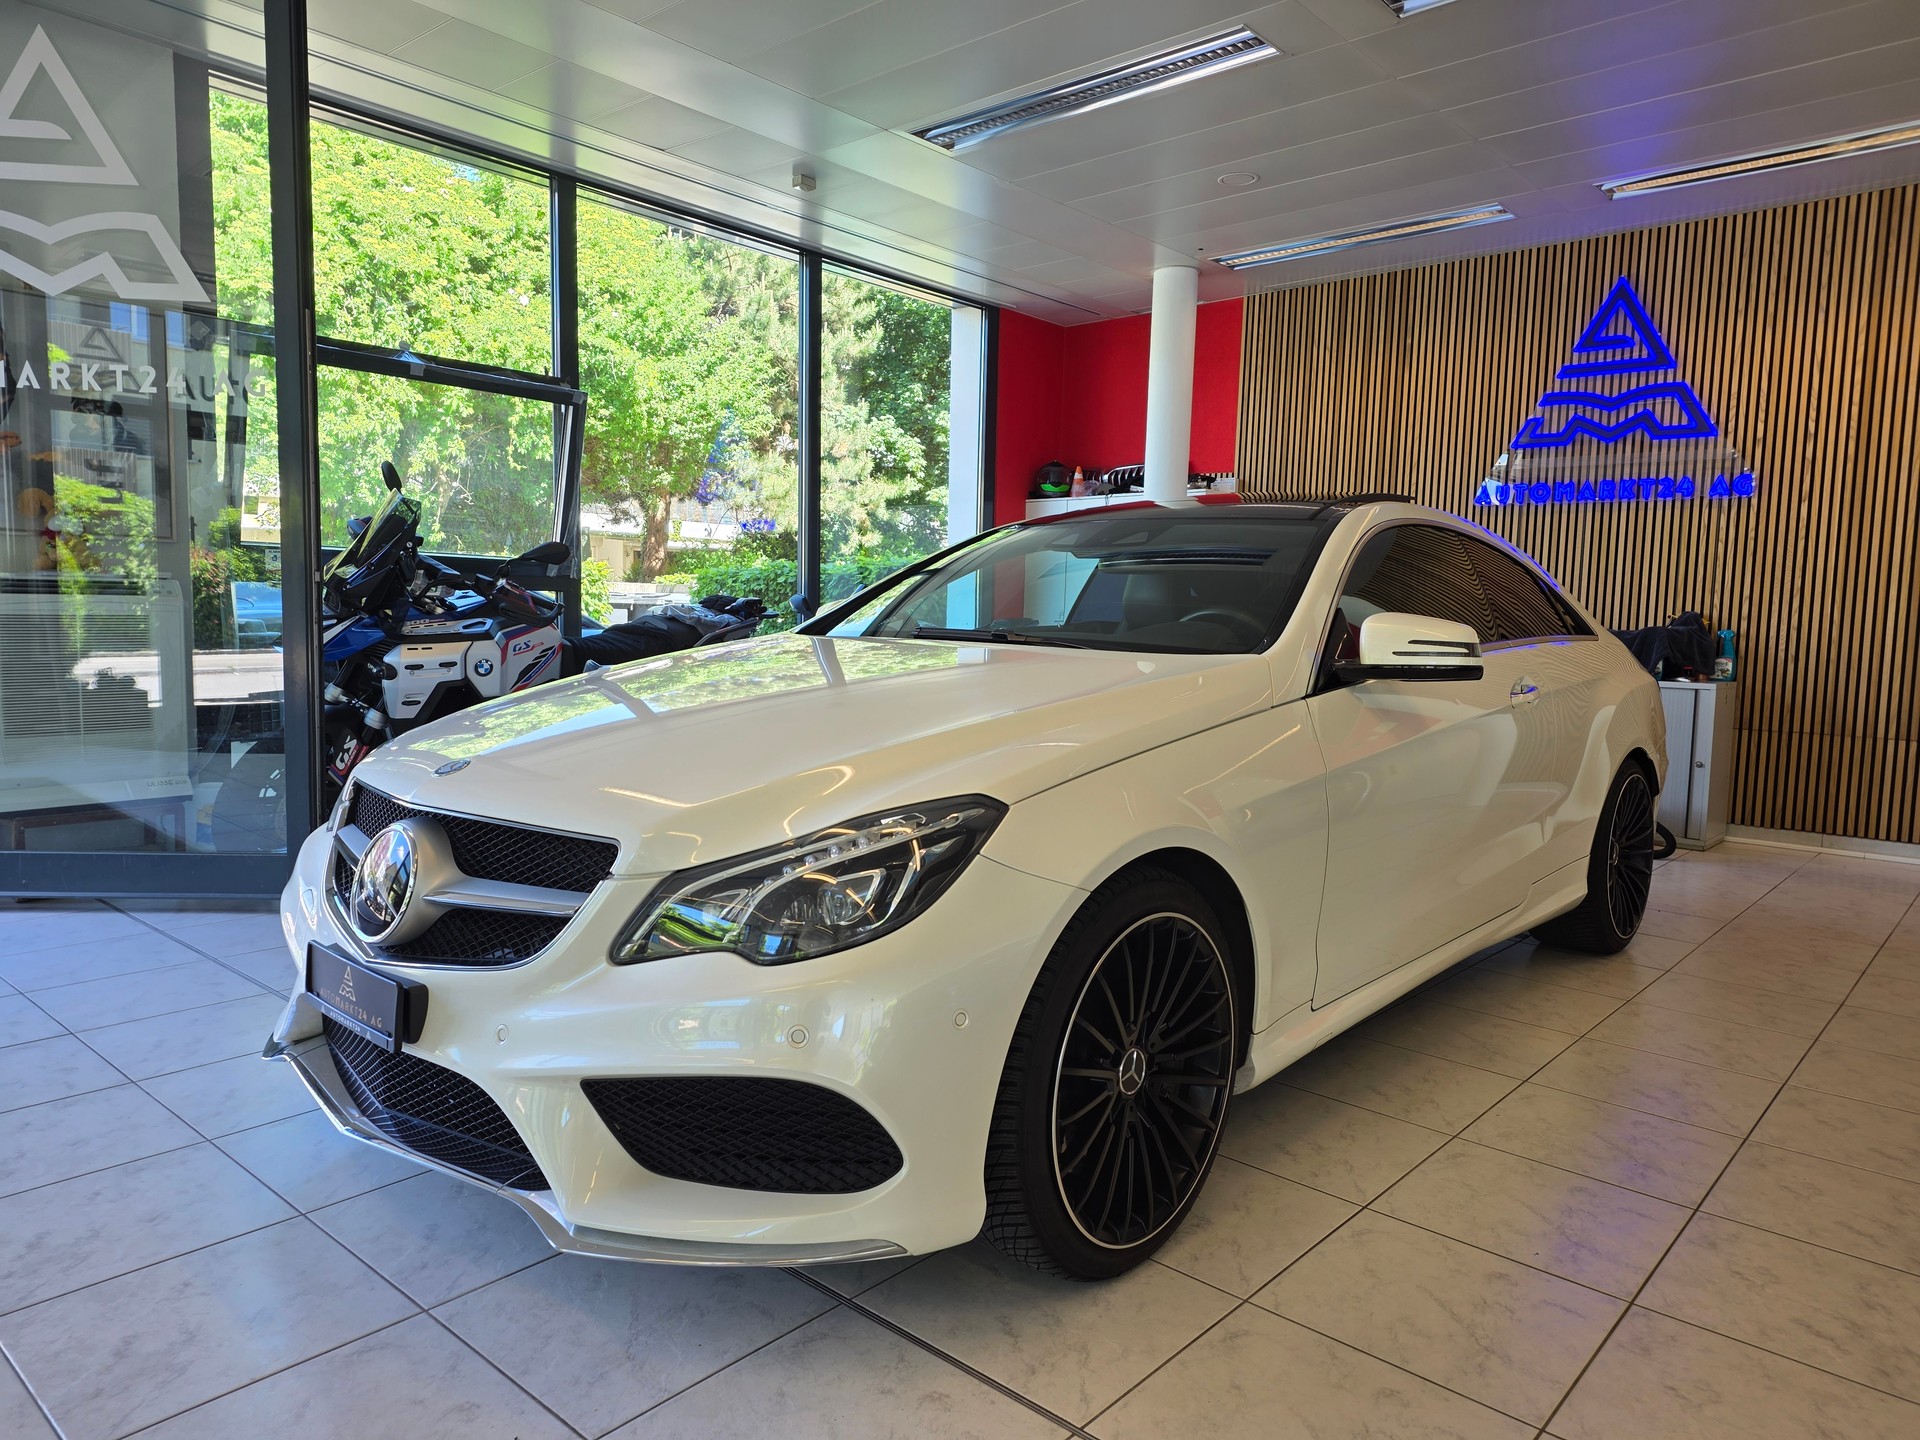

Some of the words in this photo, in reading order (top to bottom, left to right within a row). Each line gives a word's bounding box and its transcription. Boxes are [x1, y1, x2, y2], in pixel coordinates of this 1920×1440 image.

[0, 359, 187, 394] ARKT24
[213, 368, 266, 397] AG
[1474, 476, 1695, 506] AUTOMARKT24
[1707, 473, 1754, 498] AG
[320, 986, 367, 1021] AUTOMARKT24
[370, 1015, 382, 1028] AG
